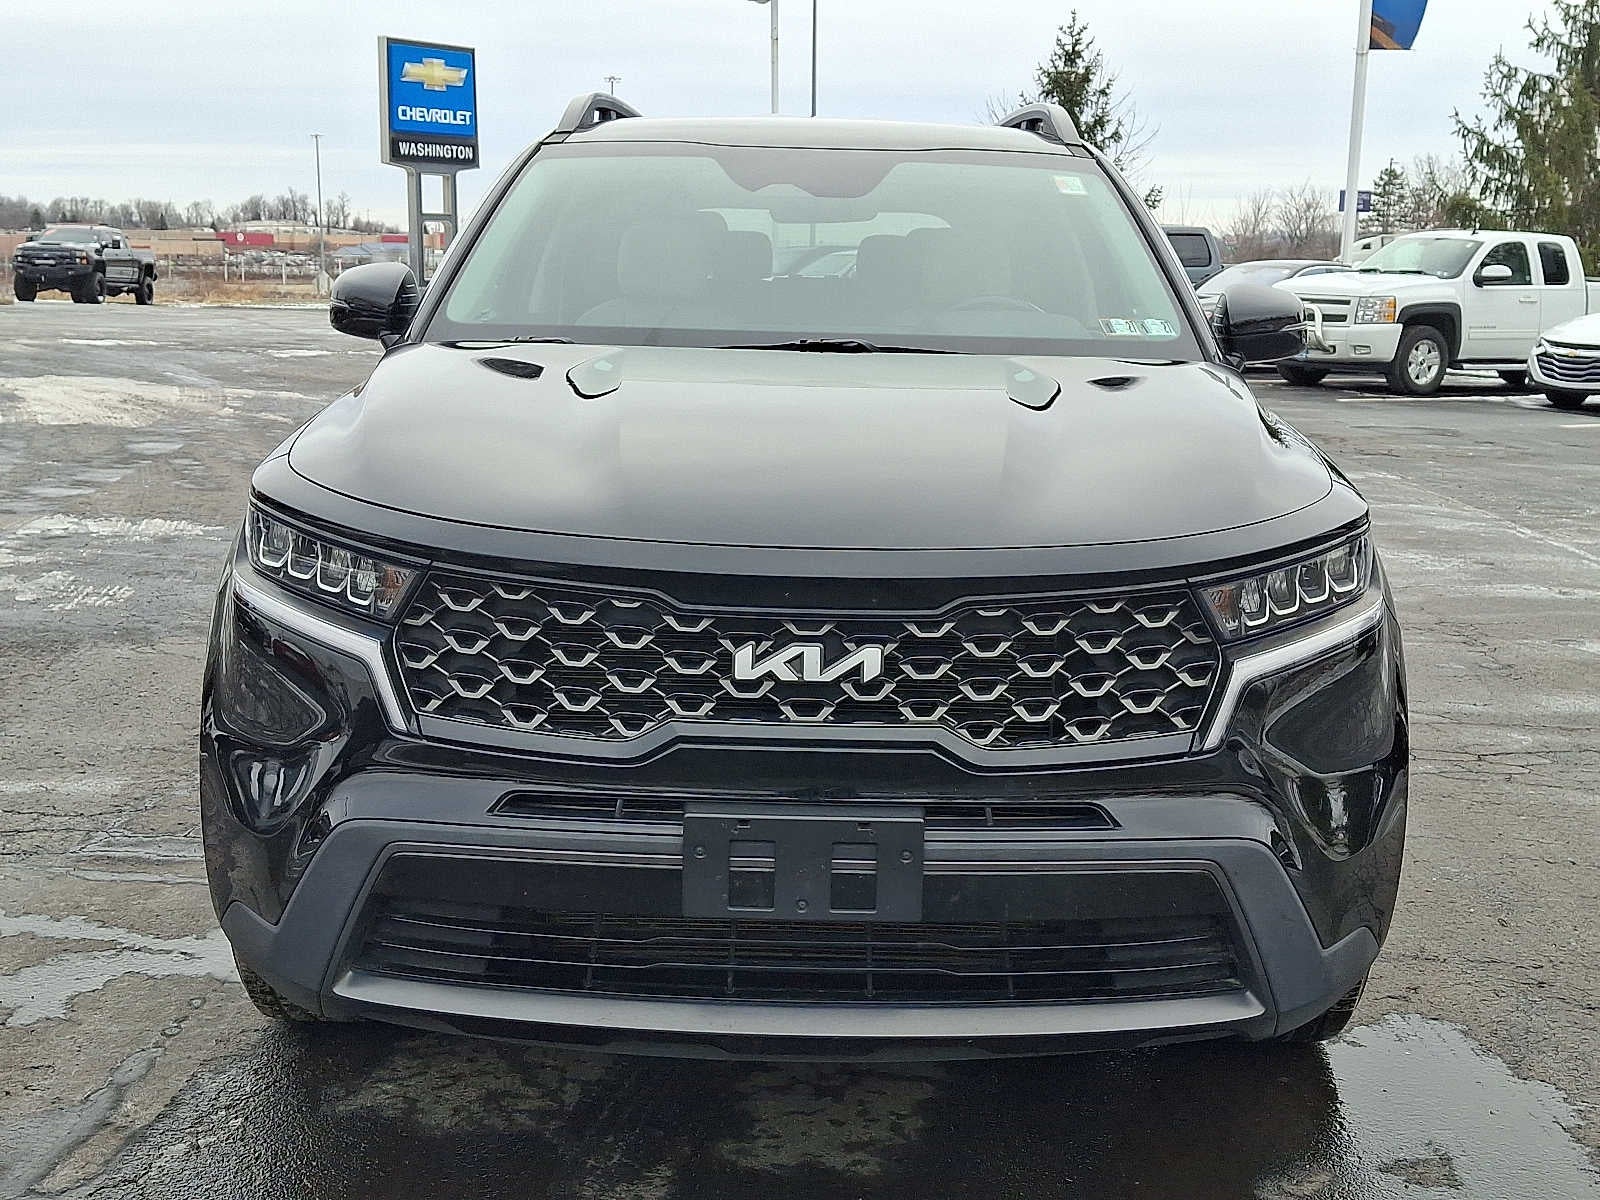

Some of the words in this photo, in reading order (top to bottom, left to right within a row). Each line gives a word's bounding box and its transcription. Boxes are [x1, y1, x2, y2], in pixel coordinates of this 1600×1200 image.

[397, 105, 472, 125] CHEVROLET
[399, 141, 473, 160] WASHINGTON
[734, 644, 882, 683] KIA
